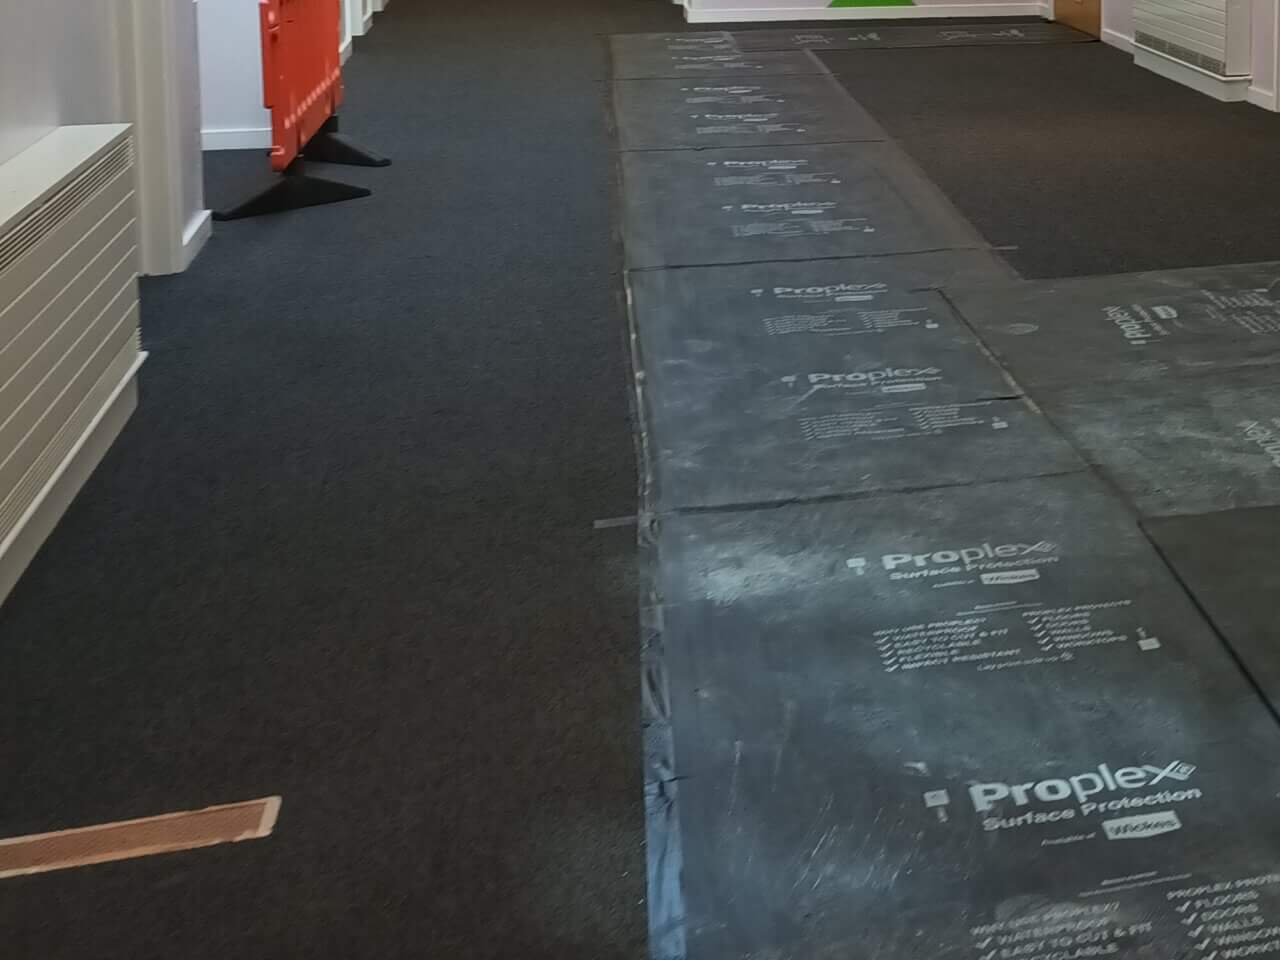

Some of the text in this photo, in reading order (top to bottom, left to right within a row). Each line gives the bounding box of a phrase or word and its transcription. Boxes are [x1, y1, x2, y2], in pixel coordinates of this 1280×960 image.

[808, 367, 943, 383] Proplex
[882, 540, 1056, 570] Proplex
[968, 760, 1196, 812] Proplex
[982, 787, 1203, 832] Surface Protection
